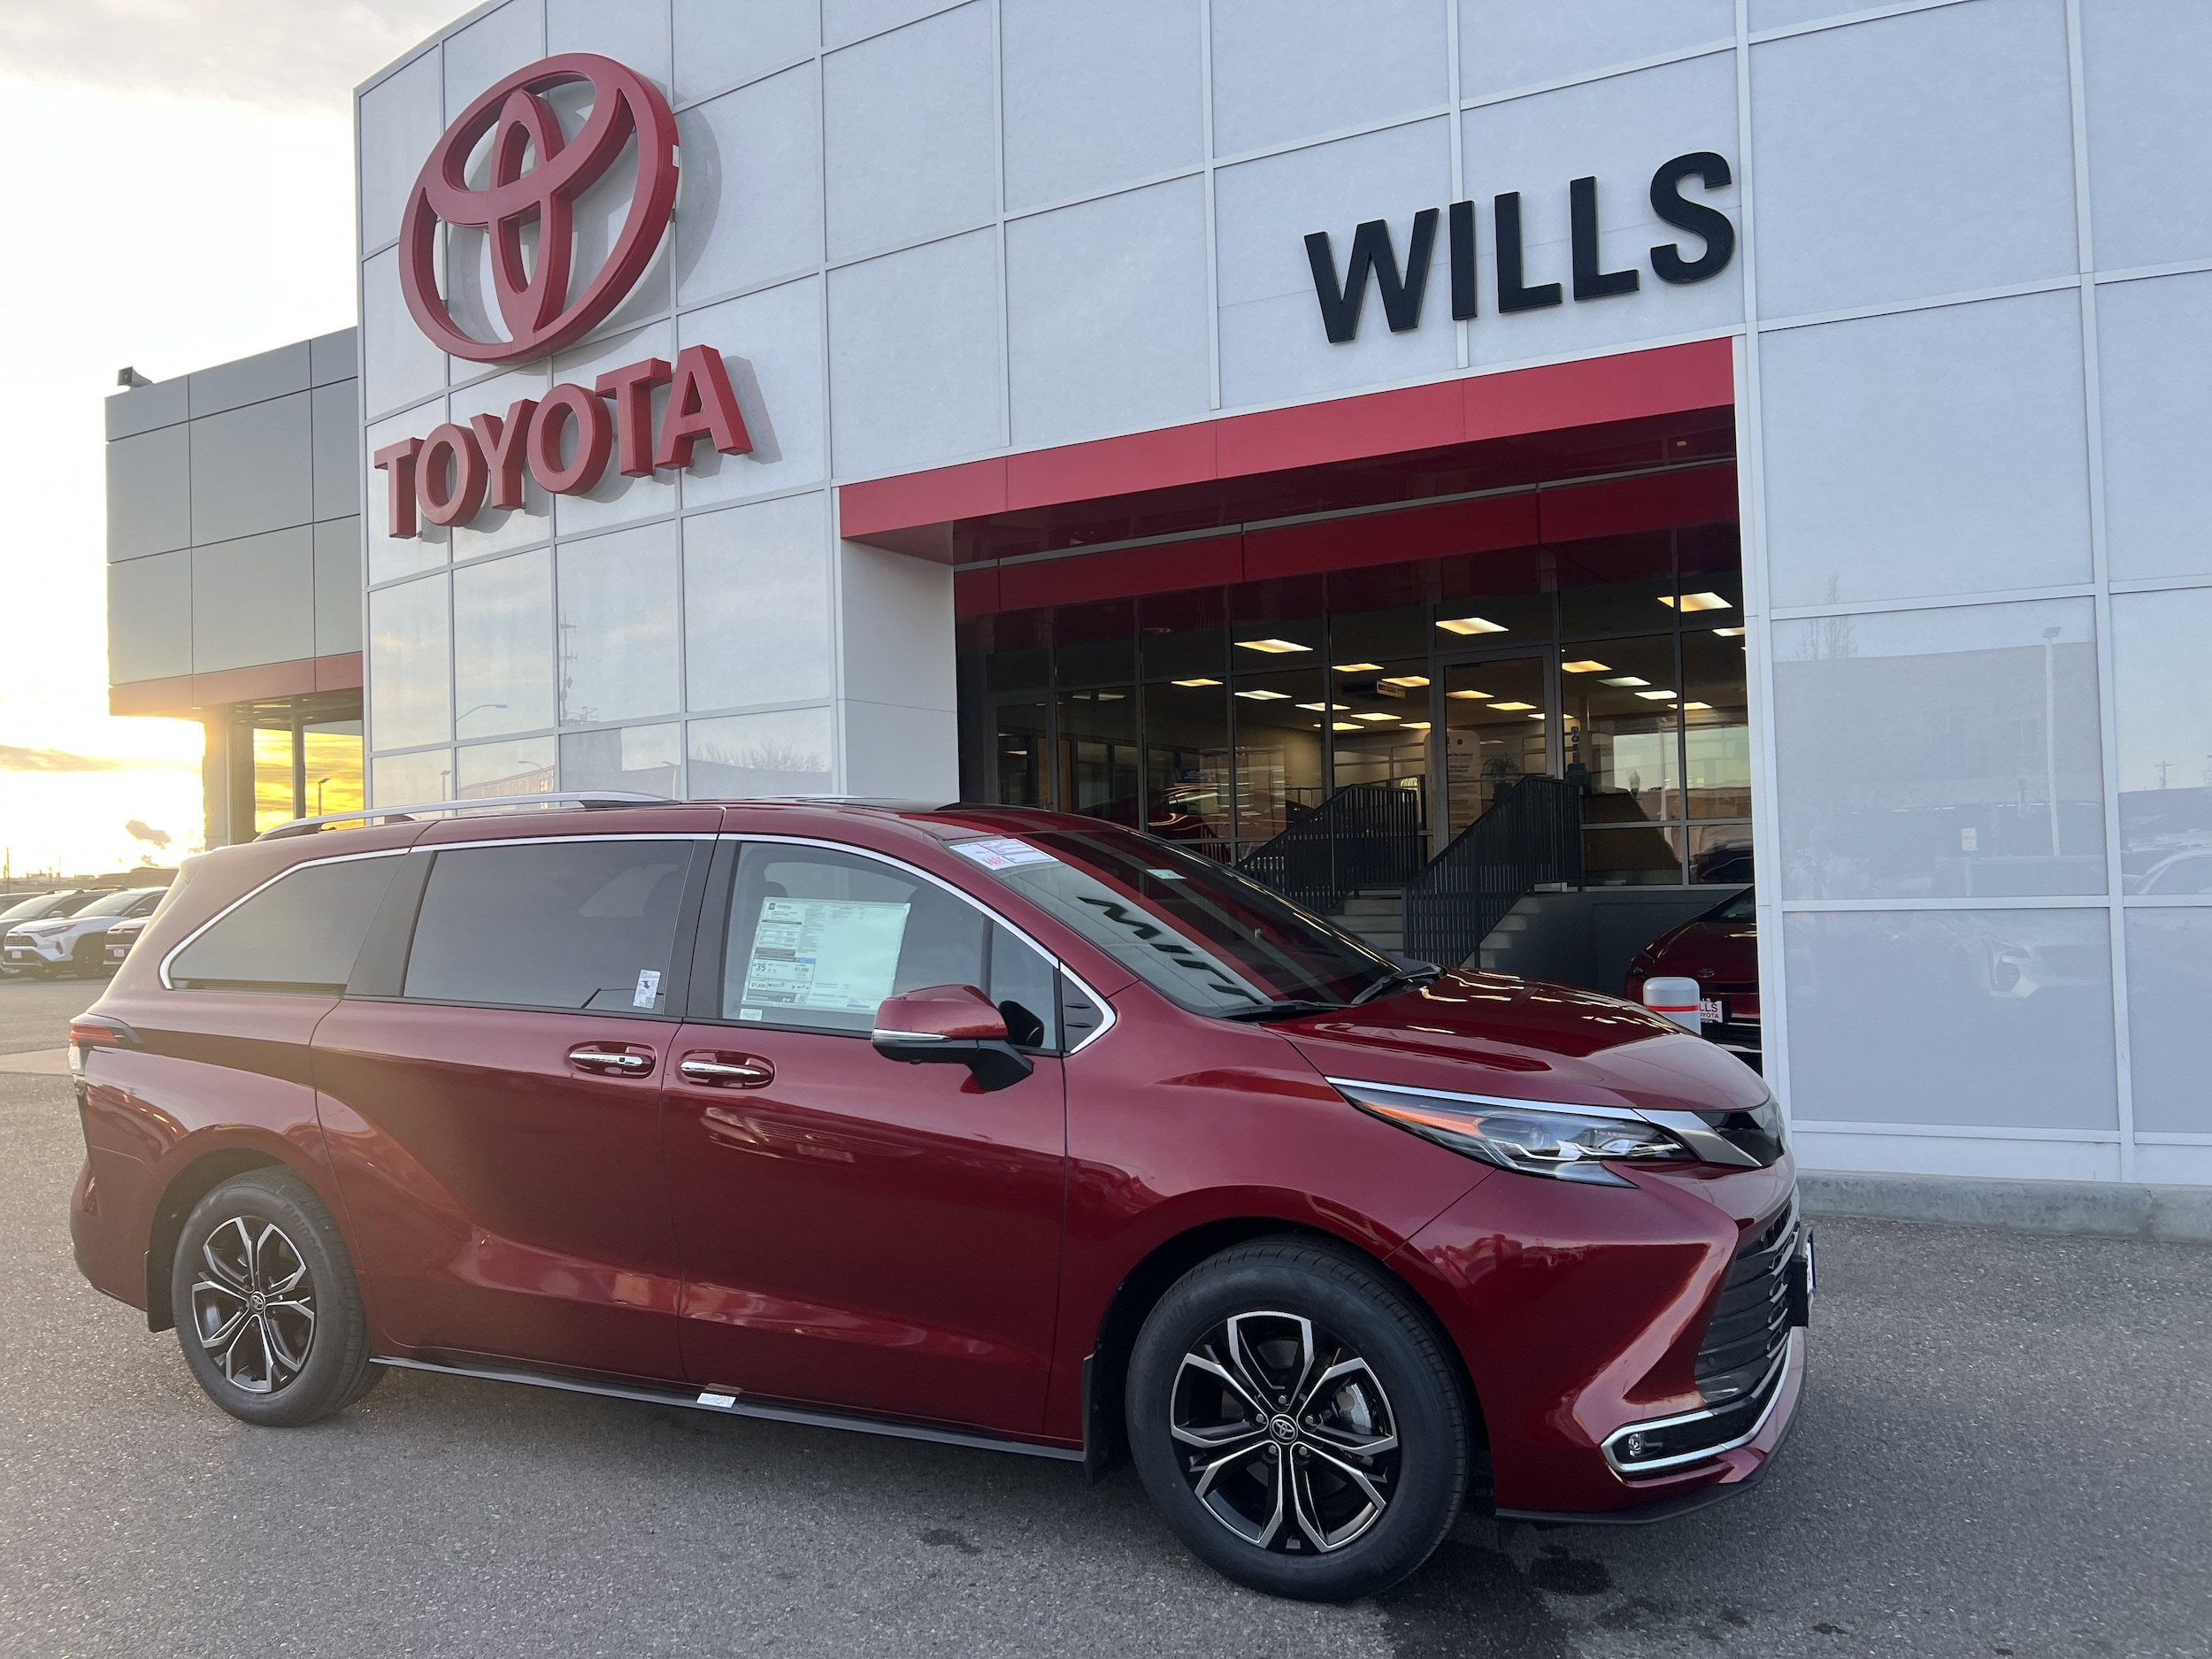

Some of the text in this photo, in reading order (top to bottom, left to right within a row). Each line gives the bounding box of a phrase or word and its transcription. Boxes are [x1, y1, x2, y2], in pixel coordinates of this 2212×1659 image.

[1303, 150, 1736, 344] WILLS
[373, 343, 753, 540] TOYOTA
[756, 963, 766, 972] 35
[1699, 1002, 1717, 1012] LLS
